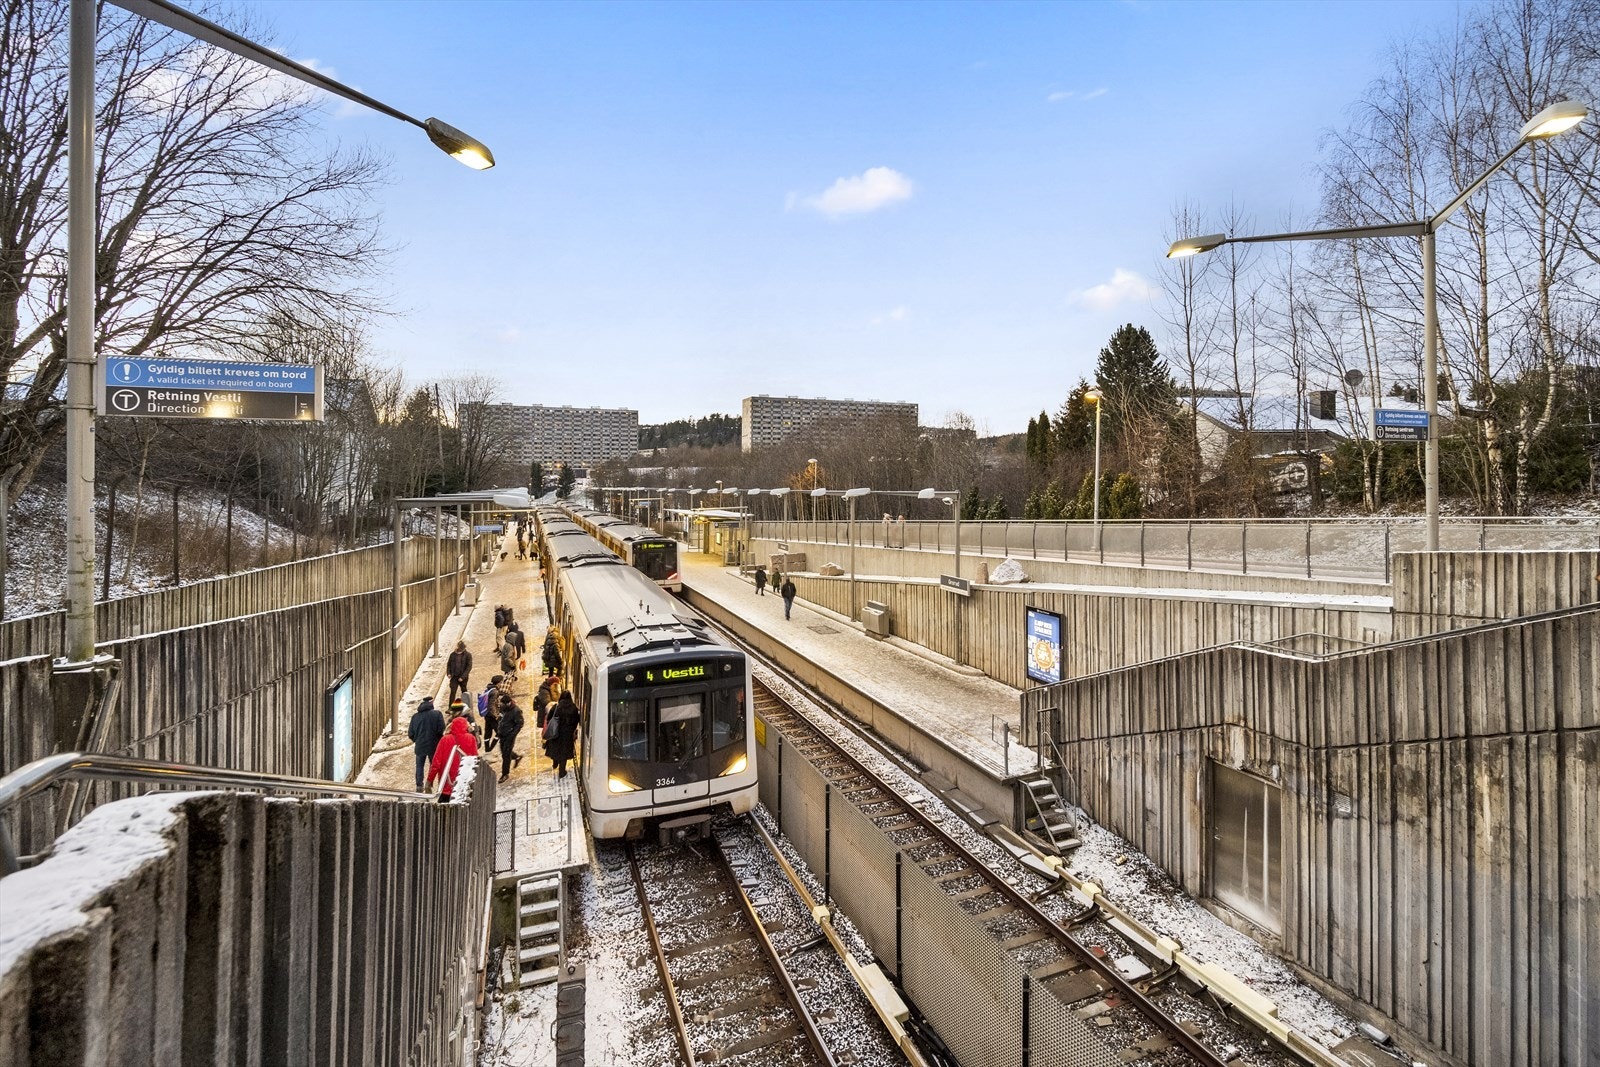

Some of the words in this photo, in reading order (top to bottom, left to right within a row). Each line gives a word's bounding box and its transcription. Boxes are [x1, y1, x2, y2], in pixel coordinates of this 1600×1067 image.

[148, 364, 184, 375] Gyldig
[188, 366, 222, 375] billett
[224, 368, 260, 377] kreves
[181, 377, 205, 385] ticket
[148, 390, 200, 403] Retning
[204, 392, 241, 402] Vestli
[148, 402, 205, 413] Direction
[647, 671, 653, 681] 4
[663, 666, 704, 678] Vestli
[656, 777, 675, 786] 3364
